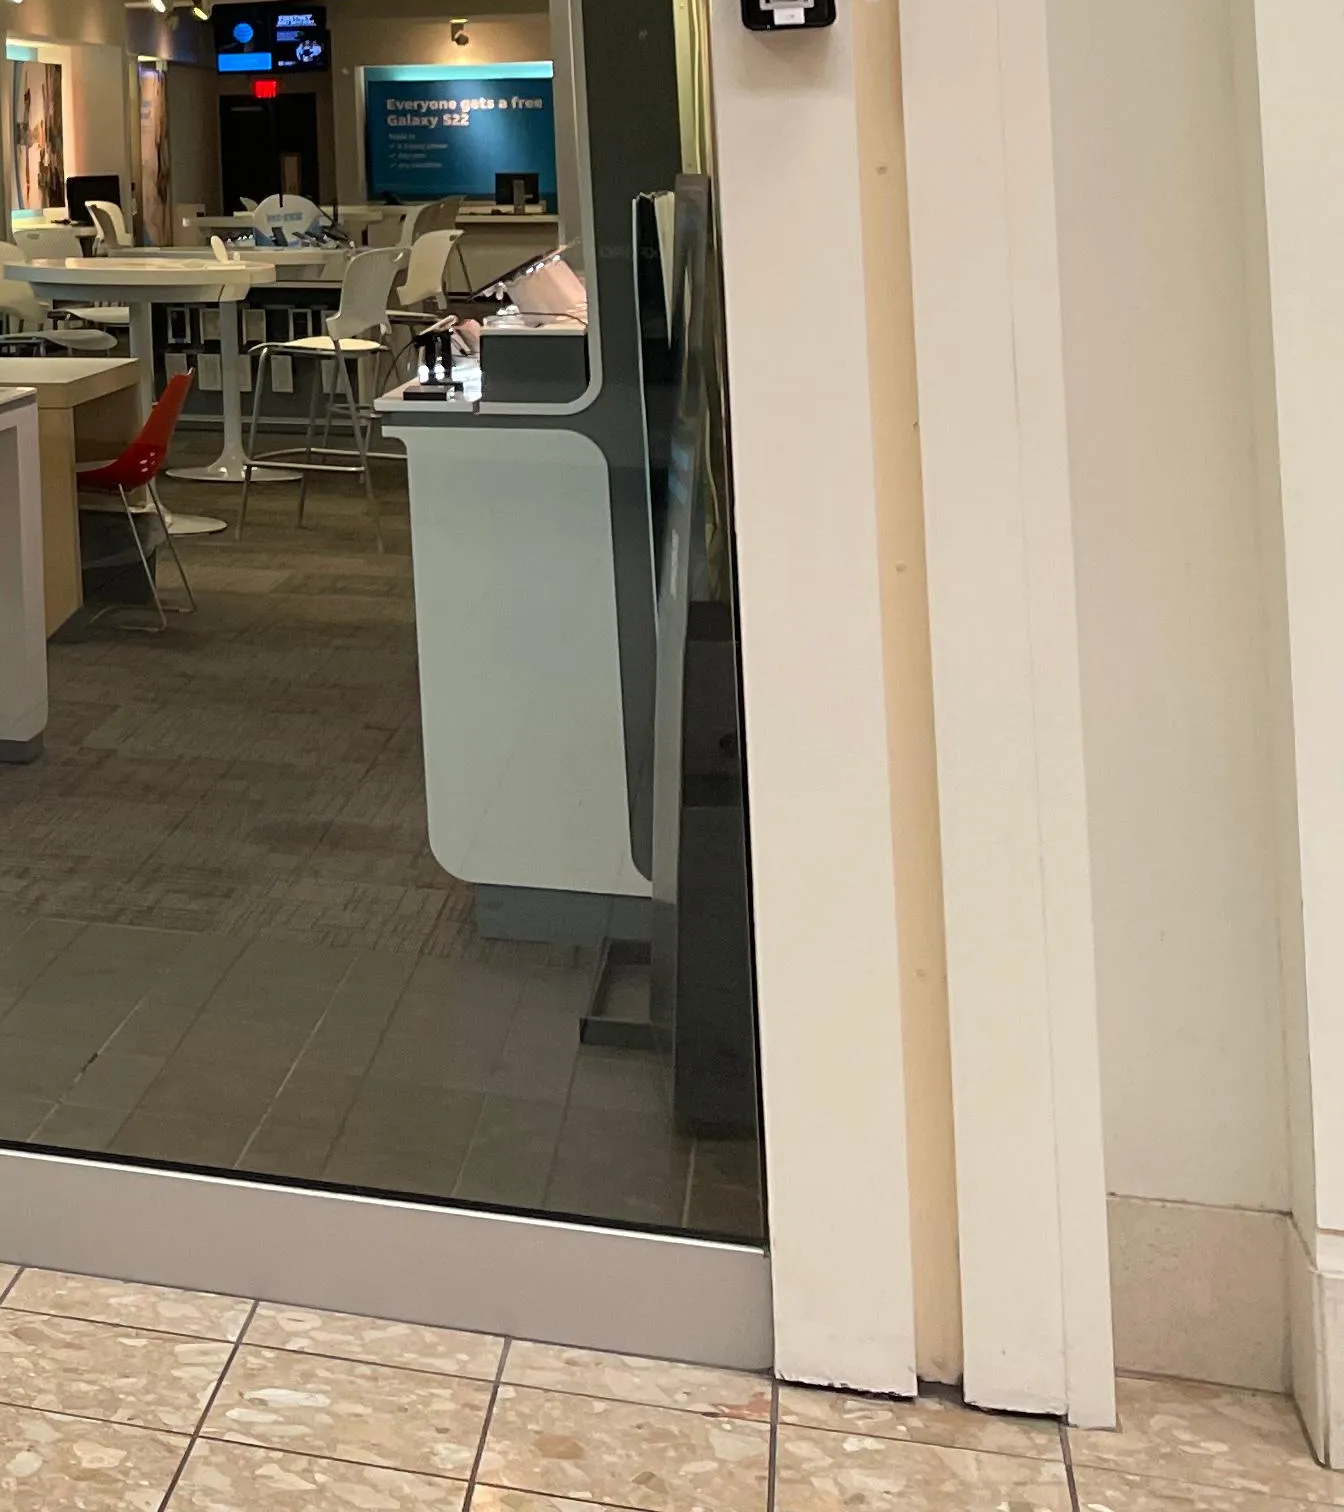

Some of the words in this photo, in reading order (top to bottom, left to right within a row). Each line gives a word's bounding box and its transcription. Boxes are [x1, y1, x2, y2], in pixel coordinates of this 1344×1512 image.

[386, 98, 458, 113] Everyone
[459, 97, 495, 113] gets
[498, 99, 509, 109] a
[511, 95, 544, 110] free
[386, 113, 439, 129] Galaxy
[442, 112, 471, 127] S22
